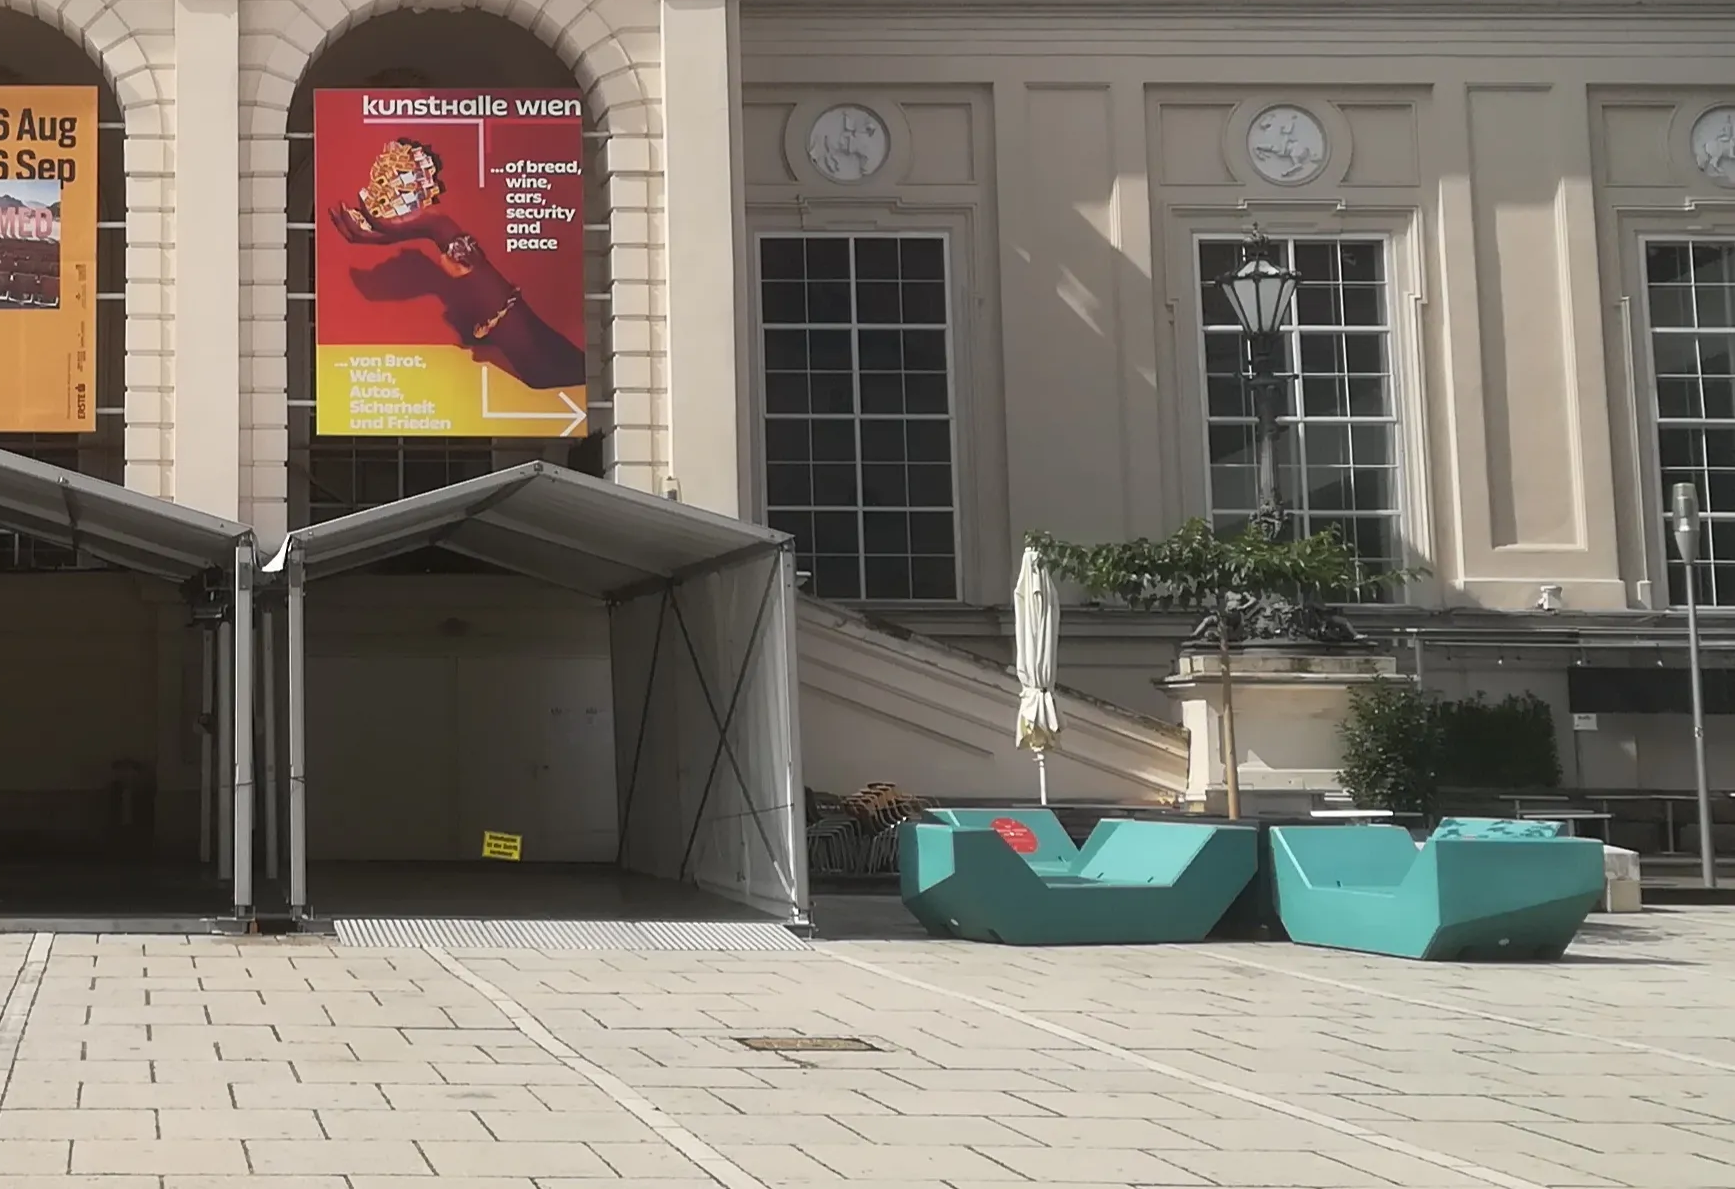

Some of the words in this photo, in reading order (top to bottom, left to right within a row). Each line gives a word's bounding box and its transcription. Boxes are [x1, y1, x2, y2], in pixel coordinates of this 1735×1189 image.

[16, 109, 77, 148] Aug
[16, 149, 76, 189] Sep
[526, 161, 582, 175] bread,
[506, 175, 552, 191] wine,
[506, 193, 546, 205] cars,
[506, 206, 575, 222] security
[506, 221, 540, 234] and
[506, 237, 558, 252] peace
[386, 354, 427, 369] Brot,
[350, 369, 396, 384] Wein,
[350, 386, 404, 400] Autos,
[350, 400, 435, 414] Sicherheit
[350, 416, 383, 429] und
[388, 416, 451, 429] Frieden
